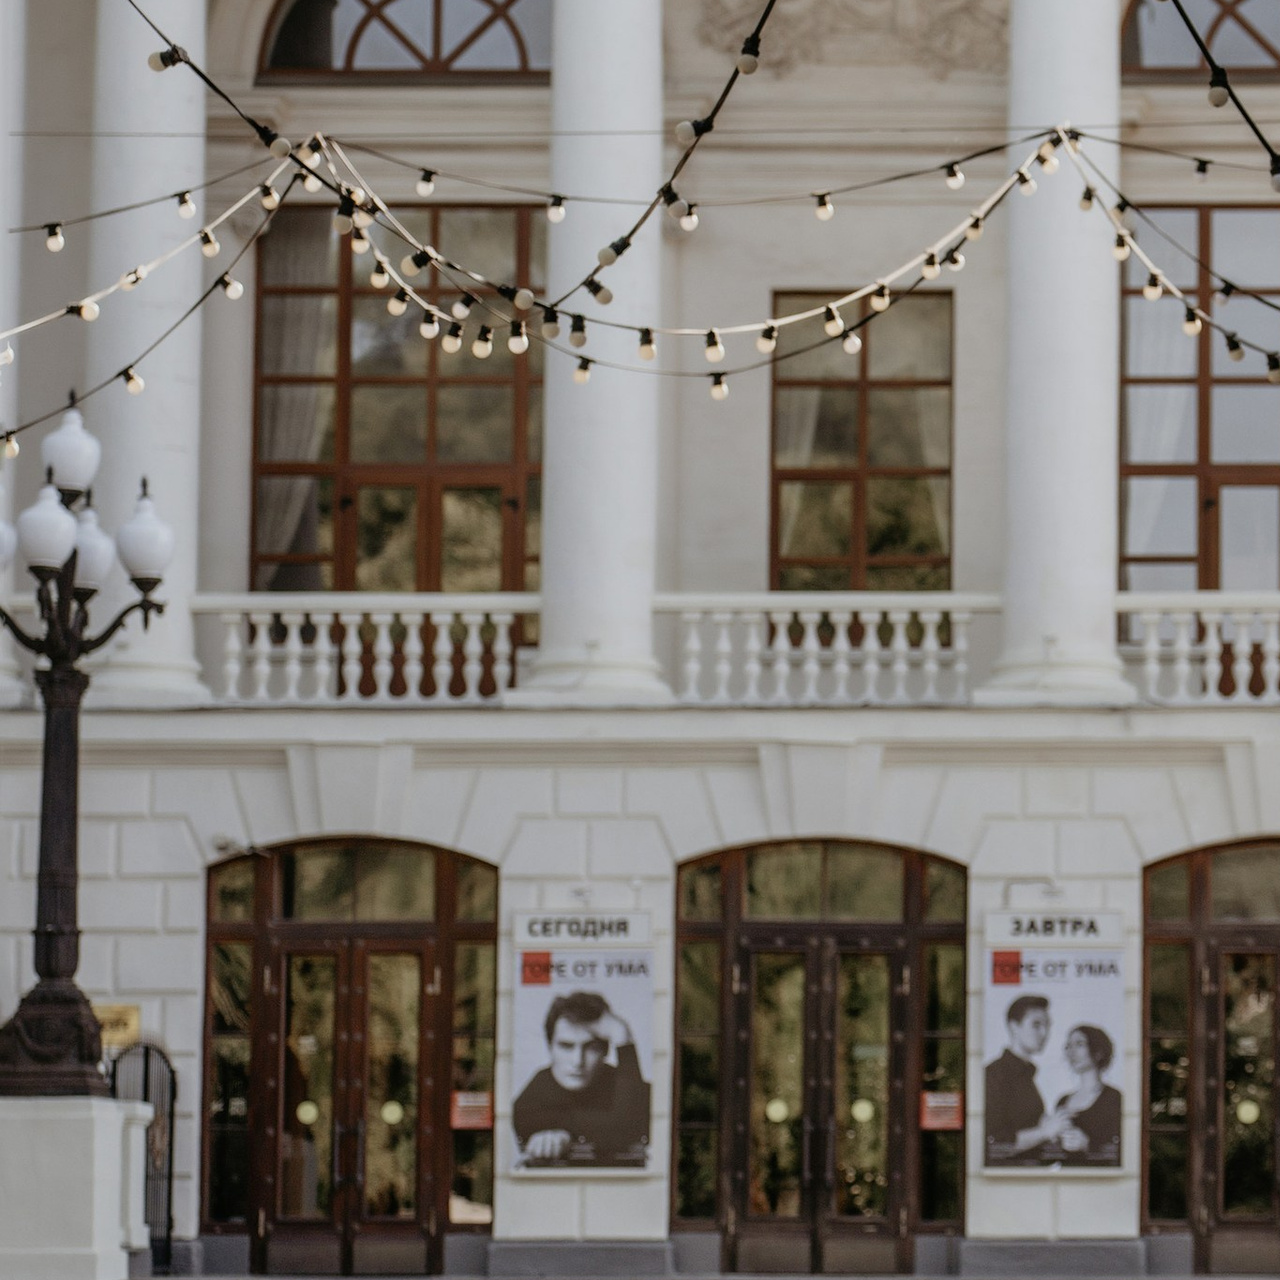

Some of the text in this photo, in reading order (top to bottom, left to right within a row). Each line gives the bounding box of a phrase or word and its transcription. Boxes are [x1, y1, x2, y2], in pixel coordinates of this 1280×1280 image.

[527, 917, 630, 939] СЕГОДНЯ
[1011, 917, 1098, 936] ЗАВТРА
[572, 960, 598, 978] ОТ
[604, 960, 649, 978] УМА
[1042, 960, 1068, 978] ОТ
[1075, 960, 1120, 978] УМА
